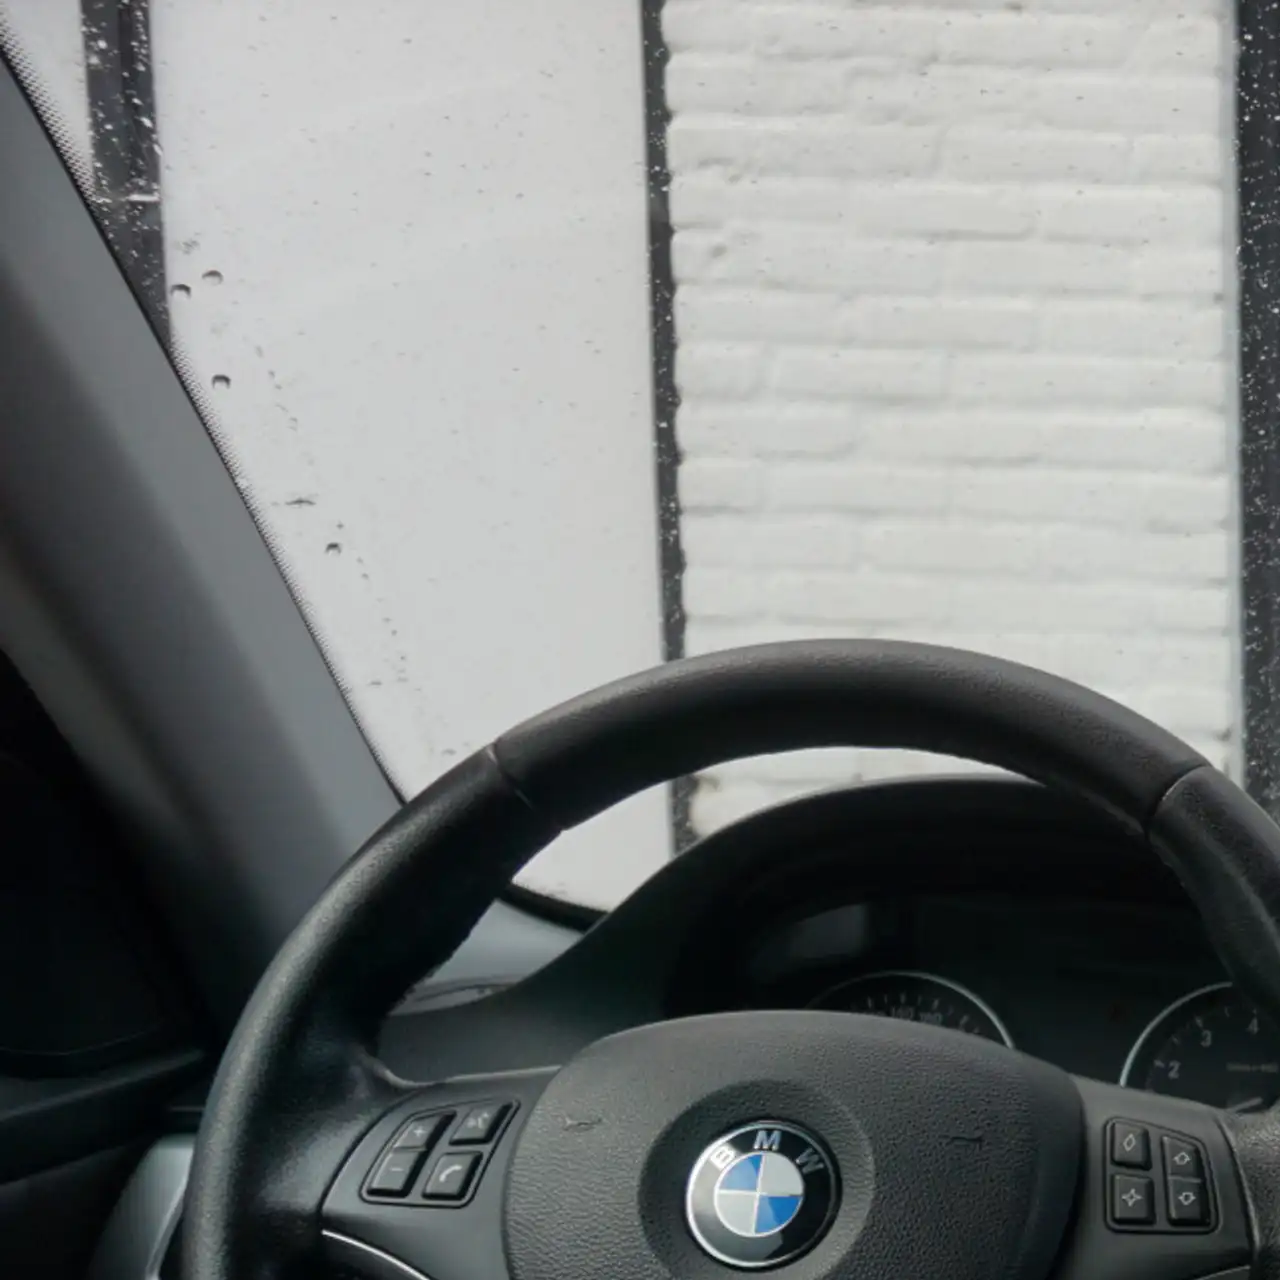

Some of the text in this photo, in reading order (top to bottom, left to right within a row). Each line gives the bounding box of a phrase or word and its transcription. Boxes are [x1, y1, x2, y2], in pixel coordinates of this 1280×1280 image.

[1246, 1016, 1260, 1036] 4
[1200, 1030, 1213, 1049] 3
[1167, 1060, 1182, 1079] 2
[709, 1129, 825, 1174] BMW
